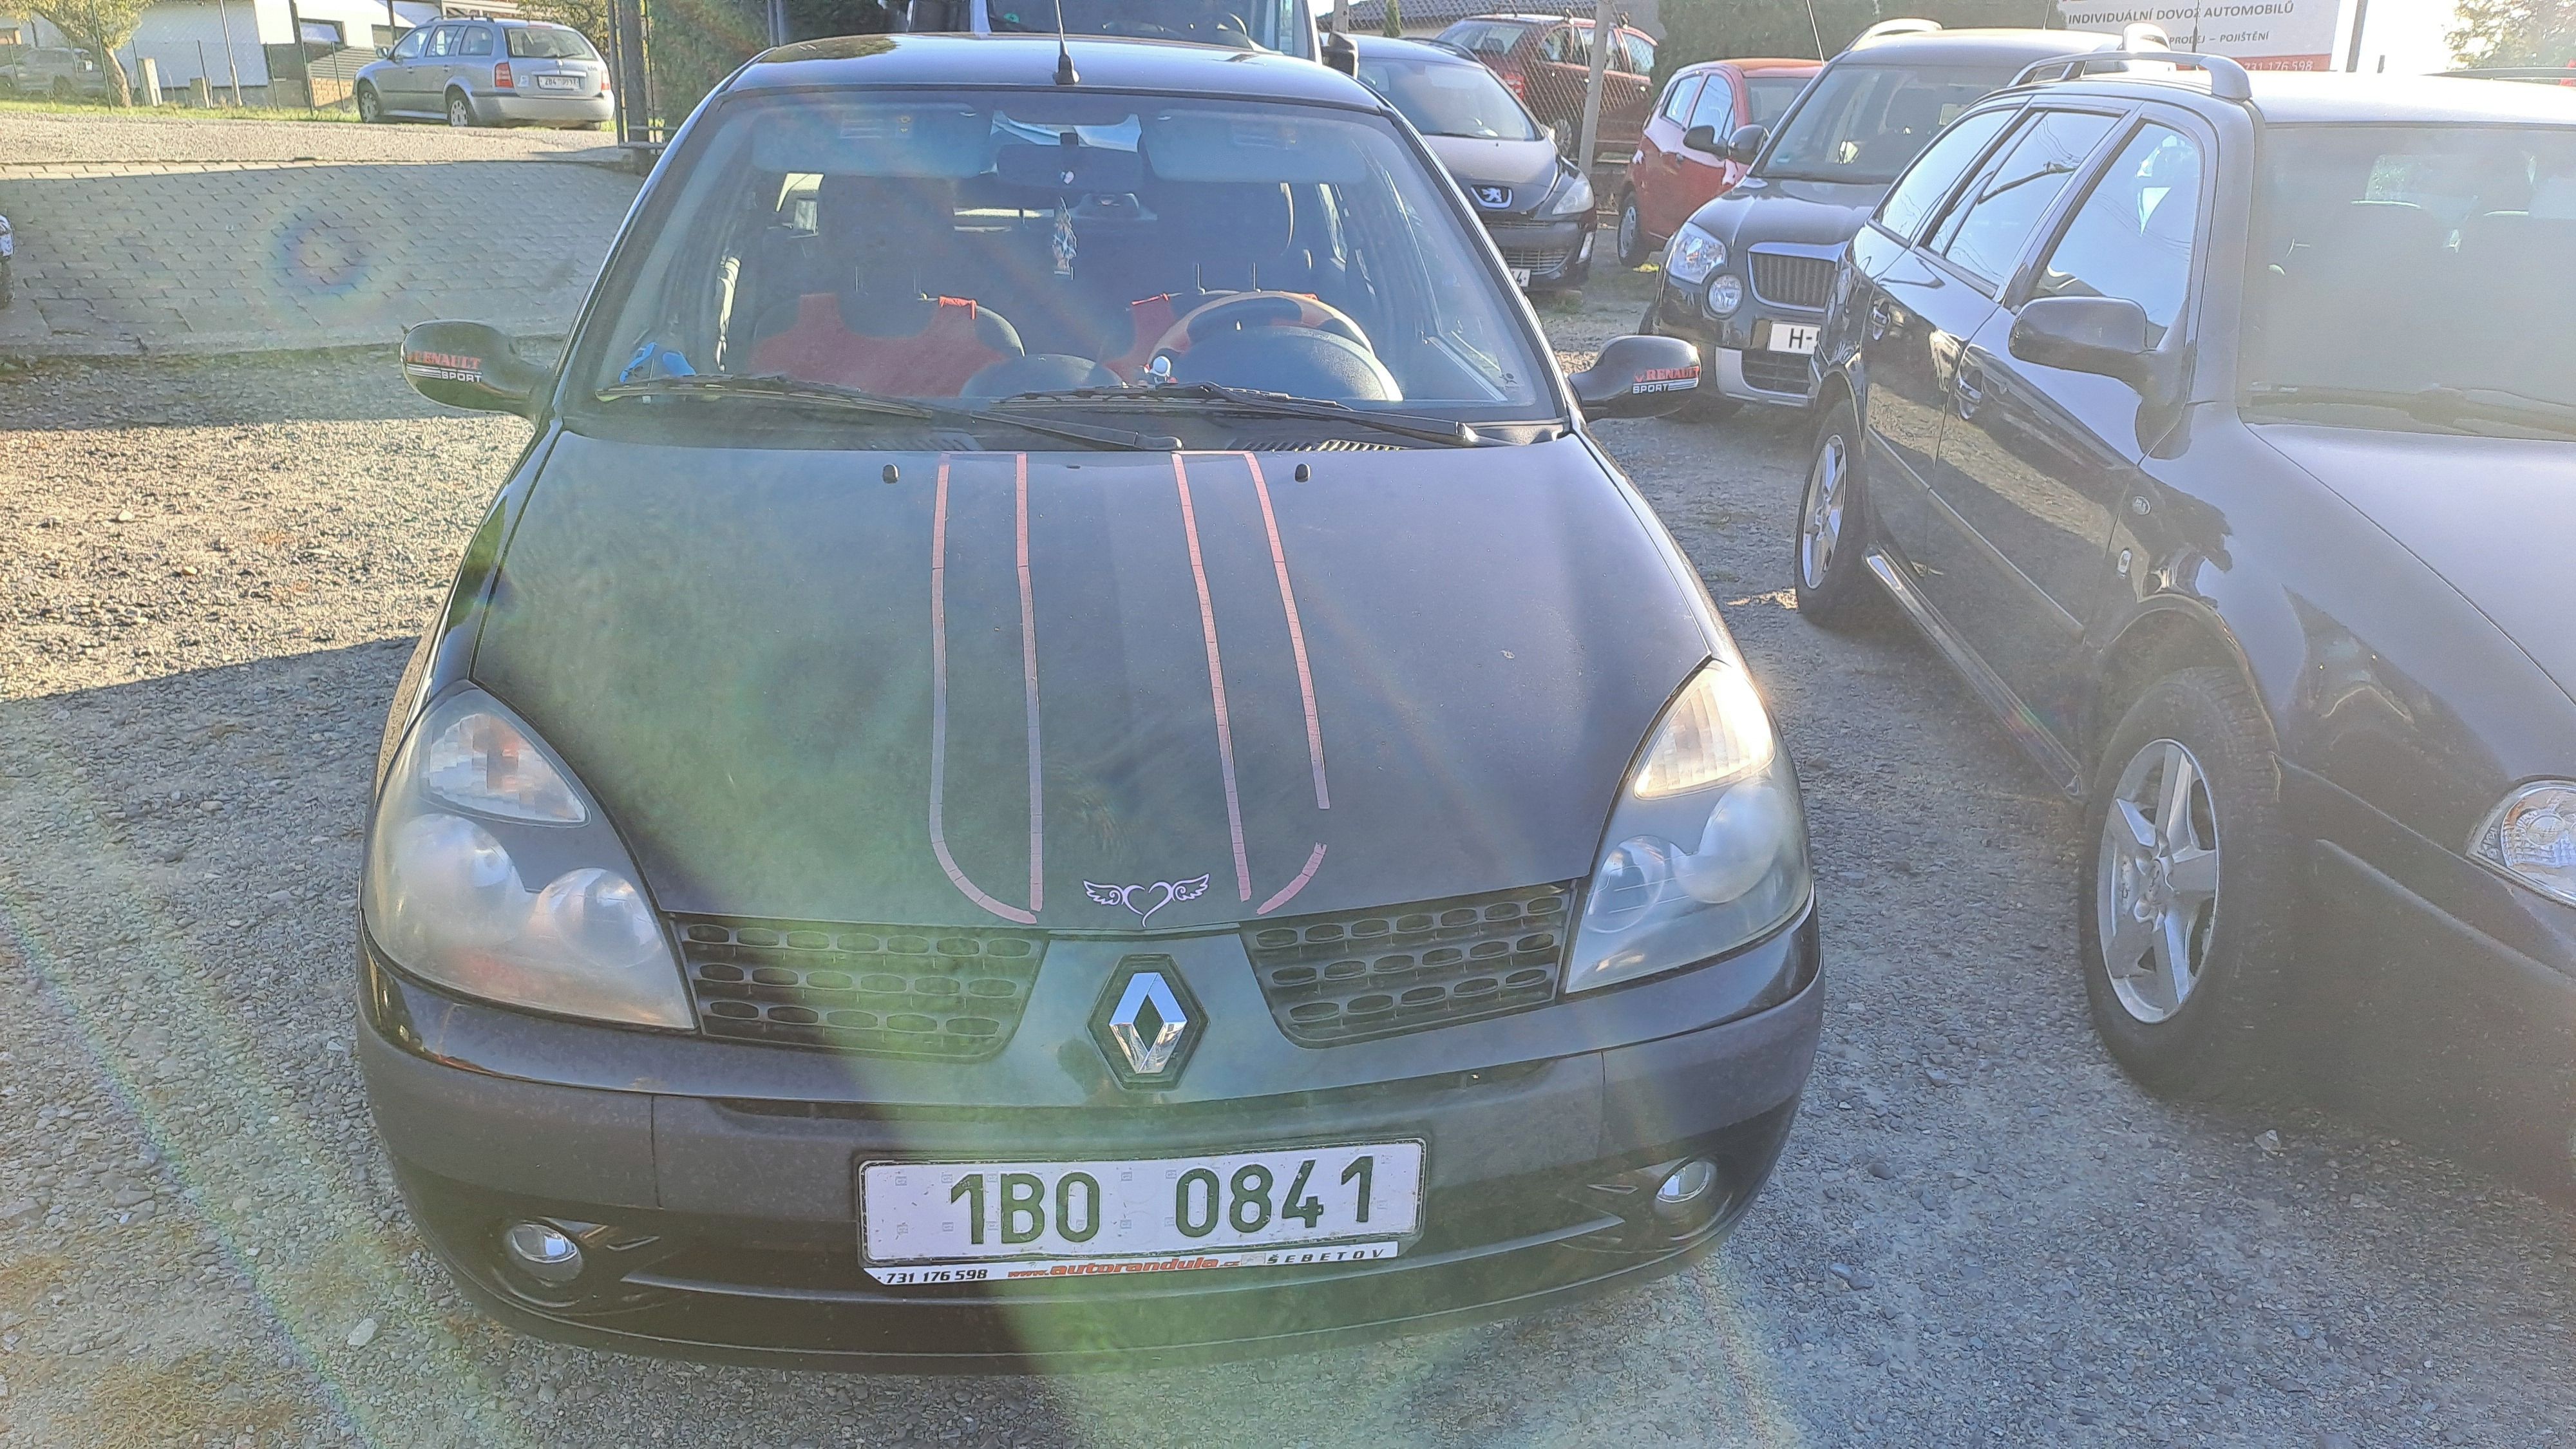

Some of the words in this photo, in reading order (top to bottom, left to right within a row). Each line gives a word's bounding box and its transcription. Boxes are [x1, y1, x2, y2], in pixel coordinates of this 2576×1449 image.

[2068, 8, 2154, 24] INDIVIDUÁLNÍ
[2156, 8, 2200, 21] DOVOZ
[2204, 1, 2295, 17] AUTOMOBILŮ
[441, 370, 482, 383] SPORT
[1646, 366, 1700, 381] RENAULT
[1633, 383, 1668, 394] SPORT
[1175, 1155, 1374, 1238] 0841
[887, 1273, 914, 1283] 731
[923, 1271, 950, 1282] 176
[954, 1269, 988, 1280] 598
[1266, 1248, 1385, 1264] ŠEBETOV
